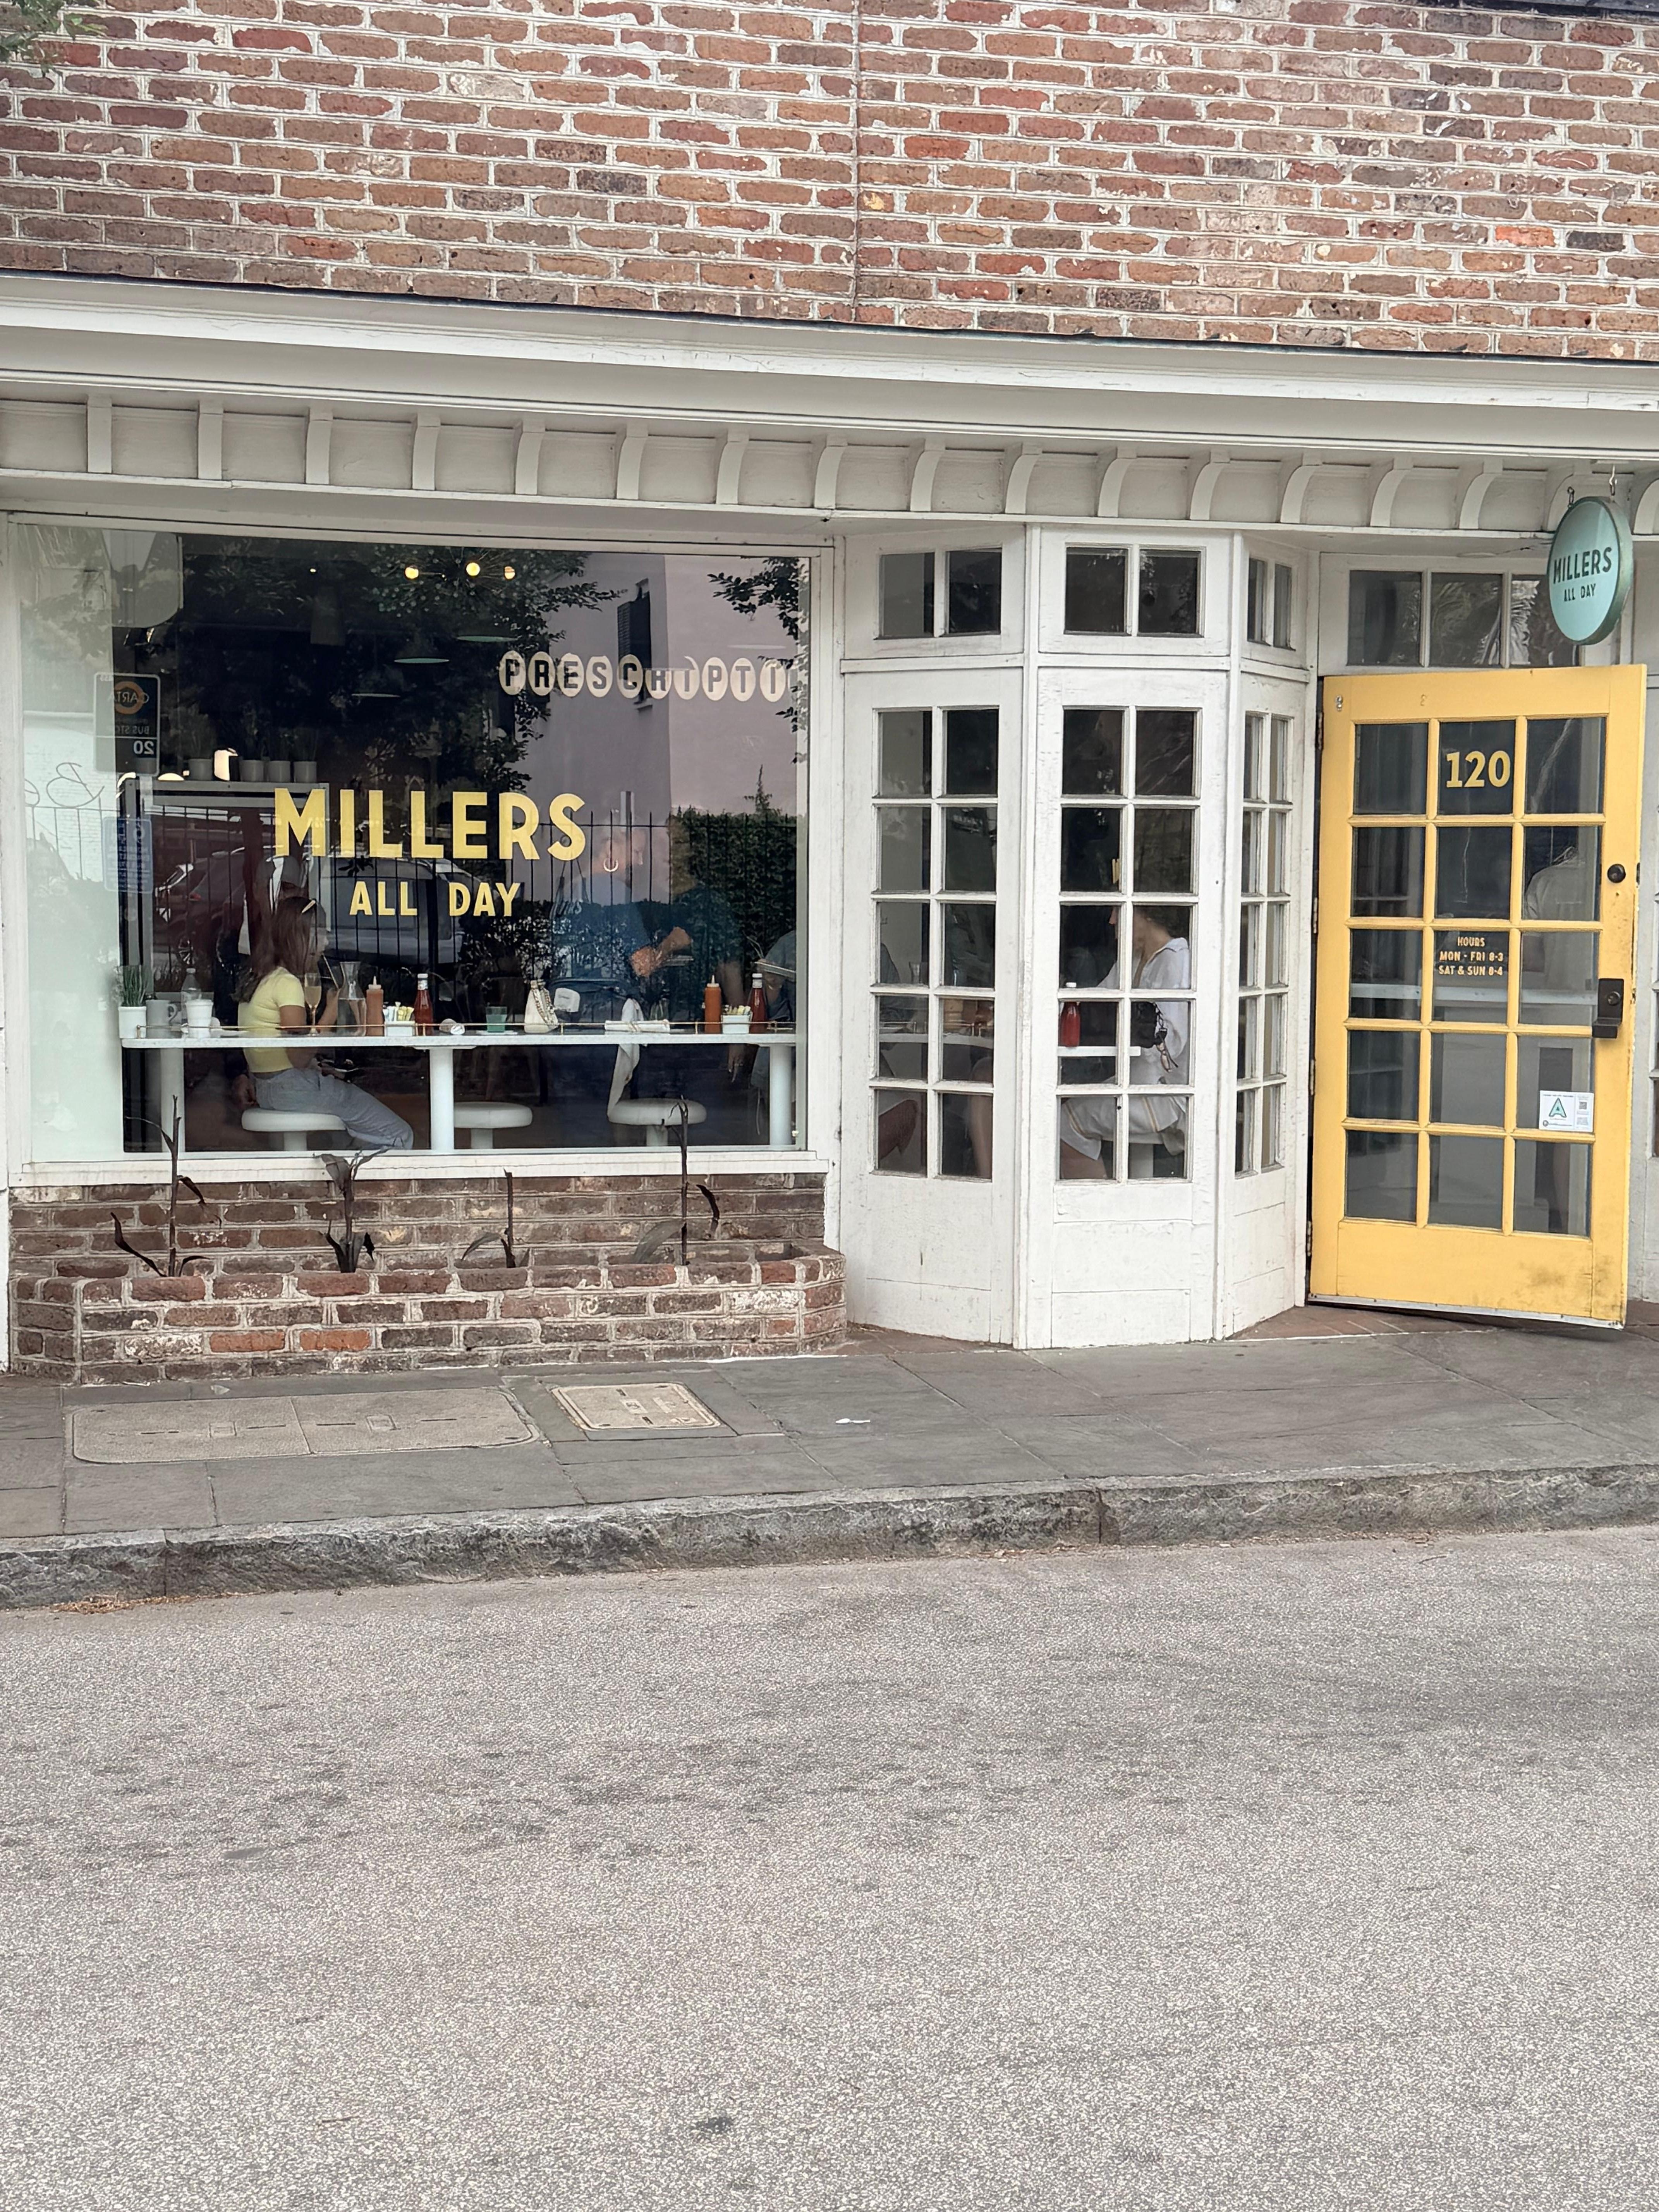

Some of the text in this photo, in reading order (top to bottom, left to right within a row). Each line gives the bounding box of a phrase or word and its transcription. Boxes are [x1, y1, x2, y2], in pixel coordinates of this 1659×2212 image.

[1553, 547, 1613, 584] MILLERS
[1563, 584, 1596, 602] ALL DAY
[1446, 750, 1511, 788] 120
[274, 788, 586, 861] MILLERS
[349, 881, 521, 917] ALL DAY
[1457, 936, 1485, 946] HOURS
[1439, 951, 1461, 961] MON
[1470, 951, 1485, 961] FRI
[1439, 965, 1455, 975] SAT
[1457, 965, 1465, 975] &
[1467, 966, 1485, 975] SUN
